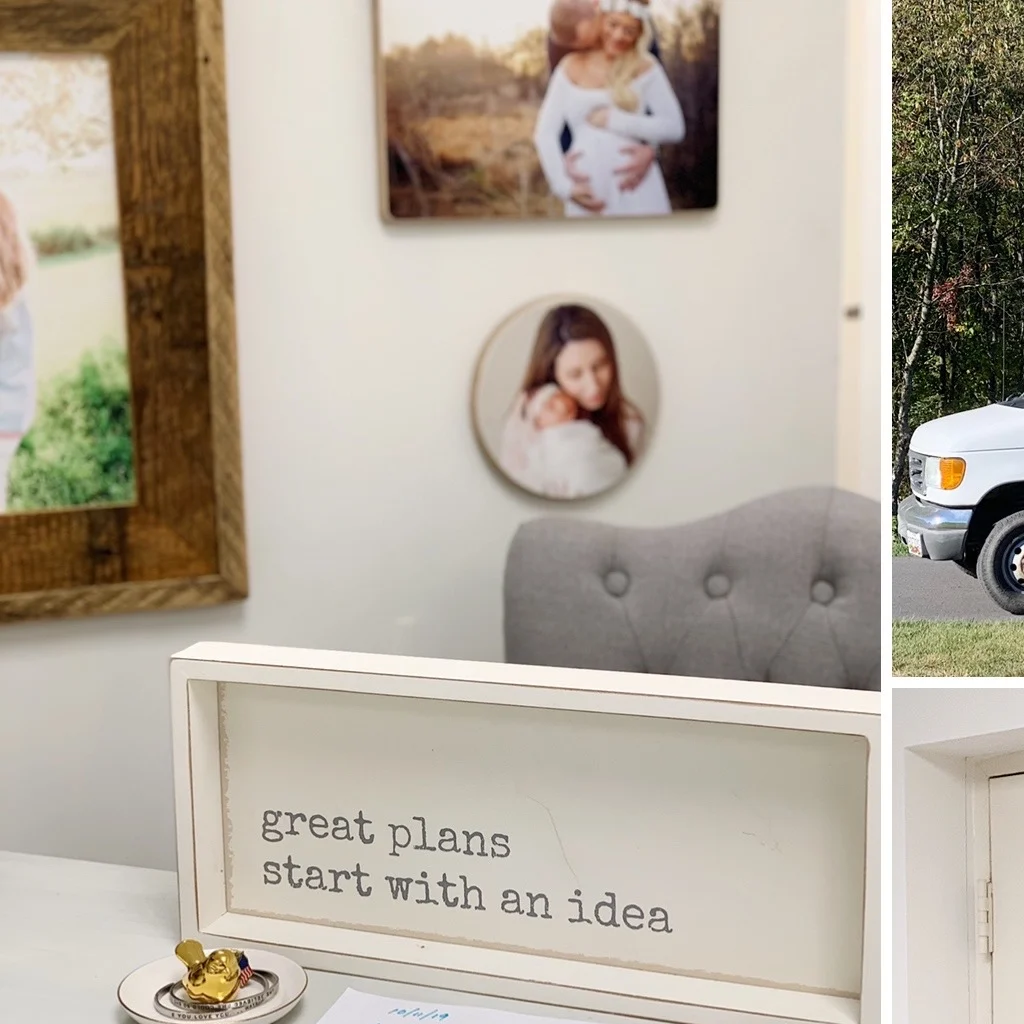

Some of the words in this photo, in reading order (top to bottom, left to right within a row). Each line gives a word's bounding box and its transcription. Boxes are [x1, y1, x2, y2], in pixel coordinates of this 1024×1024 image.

[261, 809, 375, 843] great
[388, 816, 511, 858] plans
[263, 855, 373, 898] start
[385, 871, 487, 911] with
[500, 889, 553, 920] an
[567, 889, 674, 934] idea
